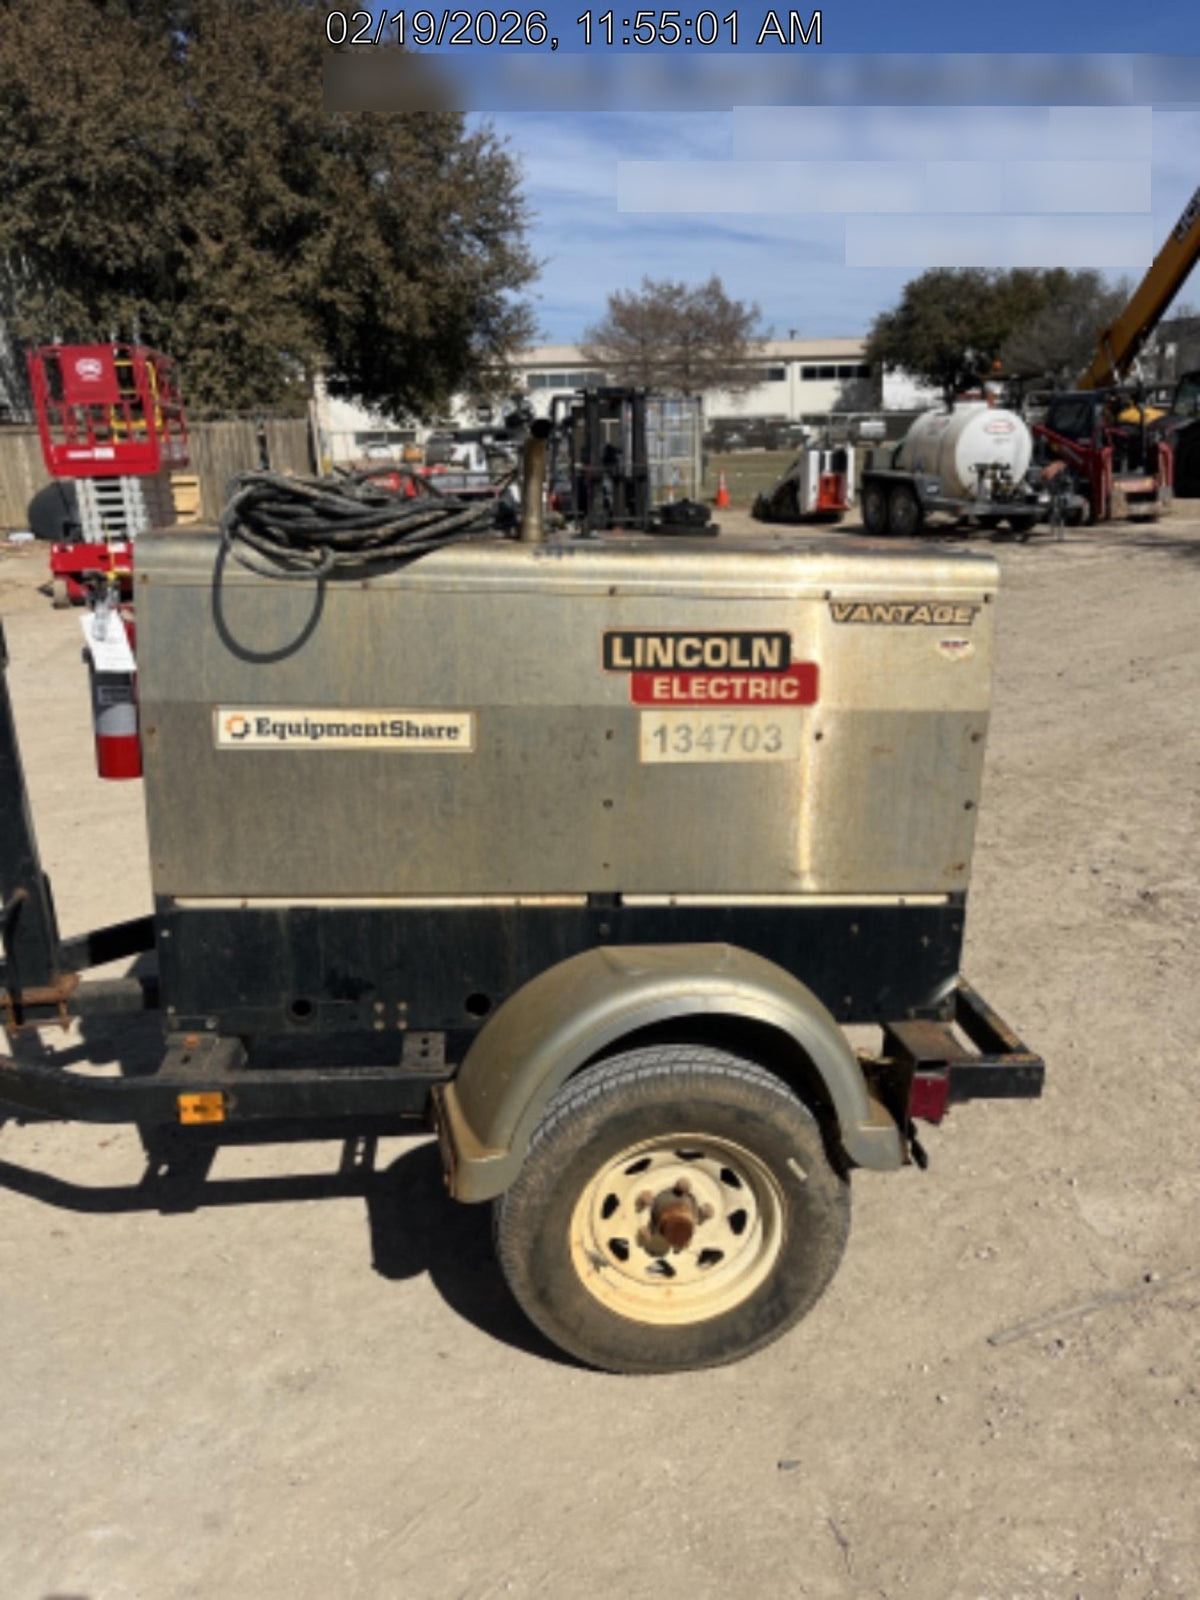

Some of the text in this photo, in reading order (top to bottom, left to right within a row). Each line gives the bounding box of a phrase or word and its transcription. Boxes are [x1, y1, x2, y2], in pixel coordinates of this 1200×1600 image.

[831, 602, 976, 624] VANTAGE
[611, 636, 782, 668] LINCOLN
[652, 677, 799, 700] ELECTRIC
[255, 717, 460, 740] EquipmentShare
[652, 722, 783, 753] 134703
